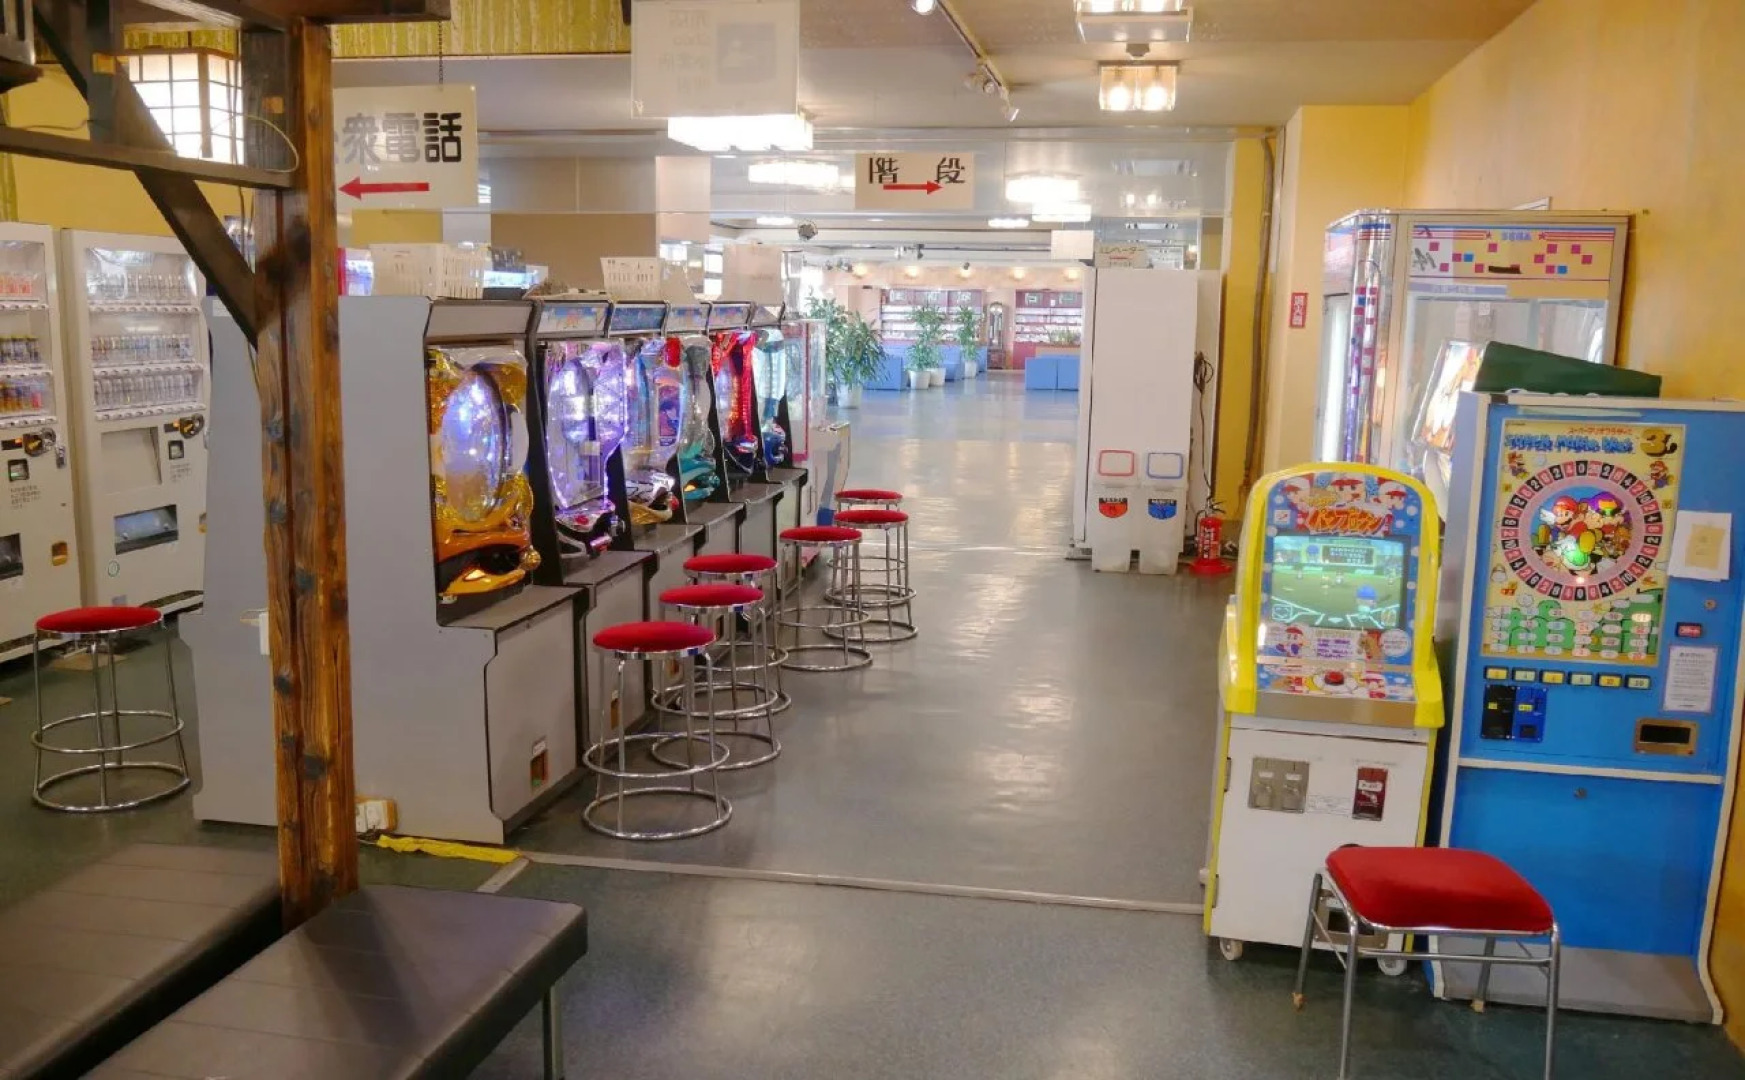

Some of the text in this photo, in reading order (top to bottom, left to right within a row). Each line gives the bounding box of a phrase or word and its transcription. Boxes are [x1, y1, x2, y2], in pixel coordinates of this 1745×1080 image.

[334, 112, 463, 165] 衆電話
[868, 157, 966, 184] 階段
